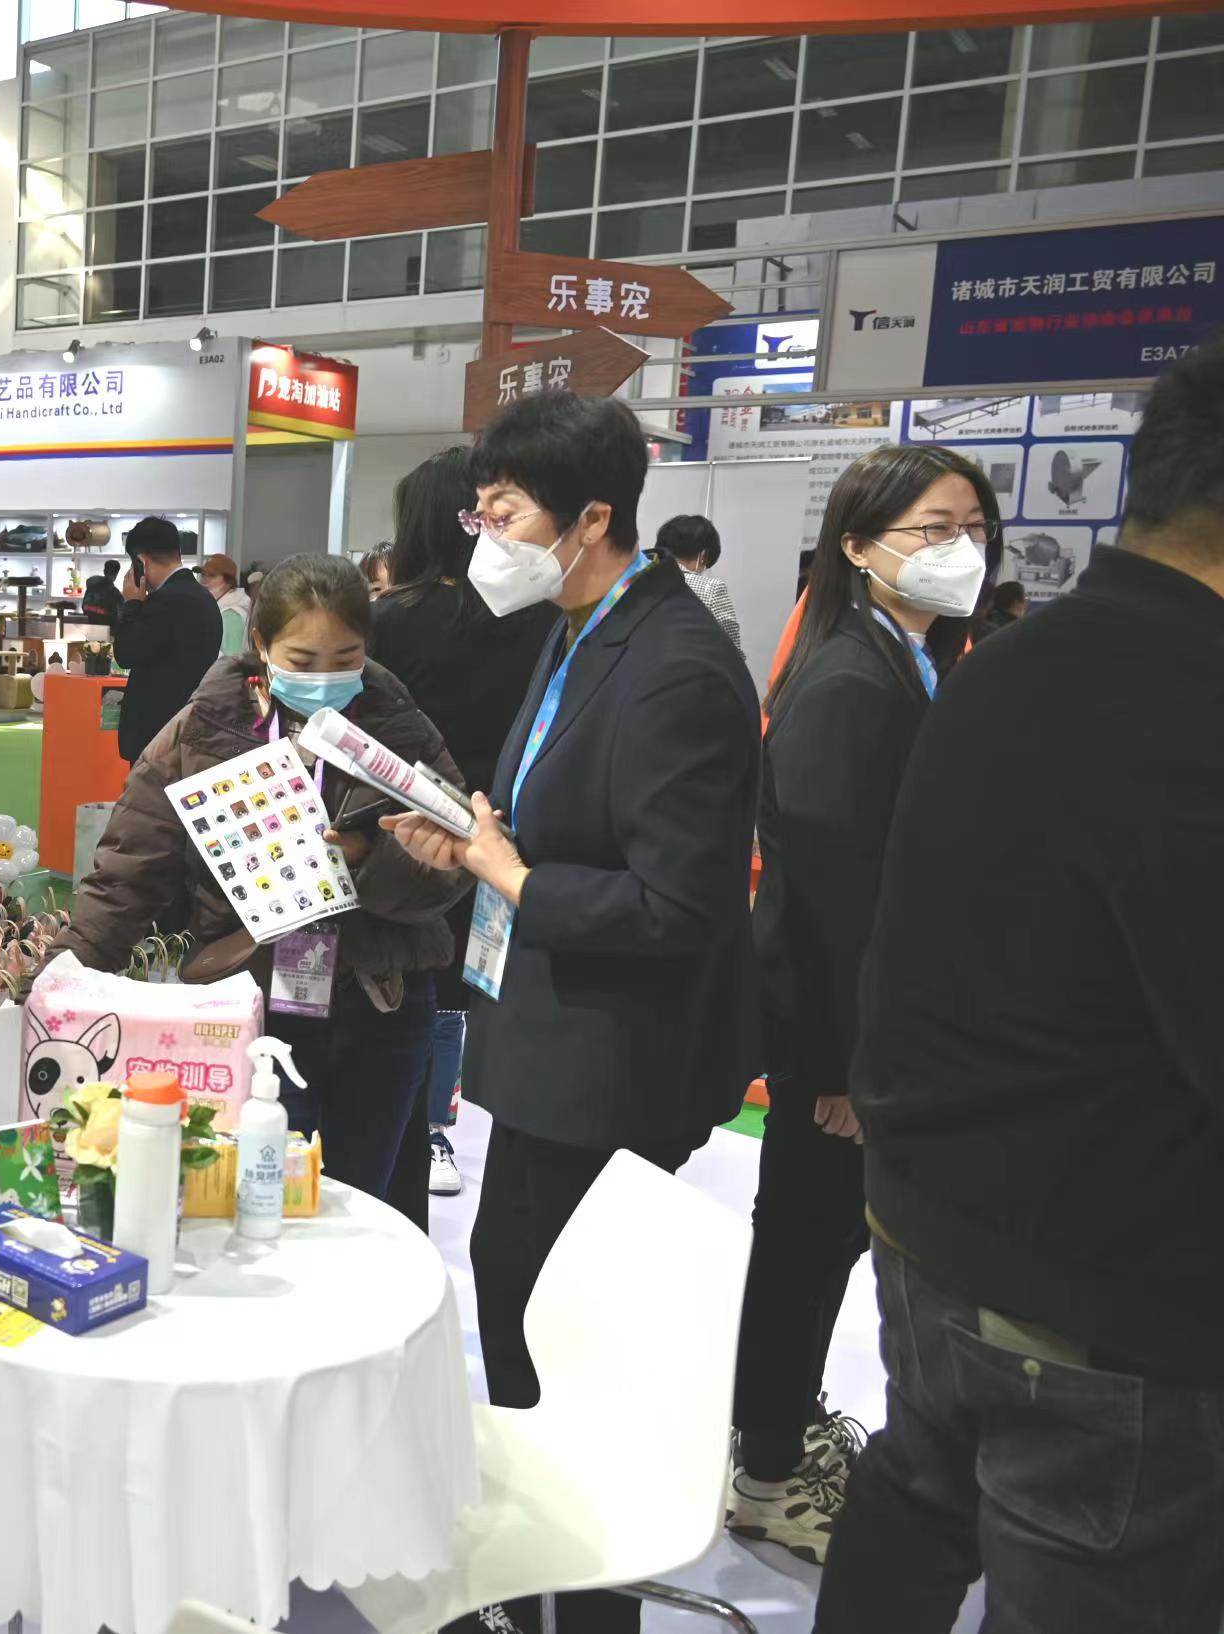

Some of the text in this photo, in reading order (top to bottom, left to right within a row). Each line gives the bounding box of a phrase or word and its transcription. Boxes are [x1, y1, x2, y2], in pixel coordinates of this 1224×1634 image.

[547, 275, 651, 320] 乐事宠
[951, 261, 1216, 302] 诸城市天润工贸有限公司
[199, 355, 225, 365] E3A02
[497, 356, 572, 406] 乐事宠
[7, 404, 70, 420] Handicraft
[102, 401, 123, 415] Ltd
